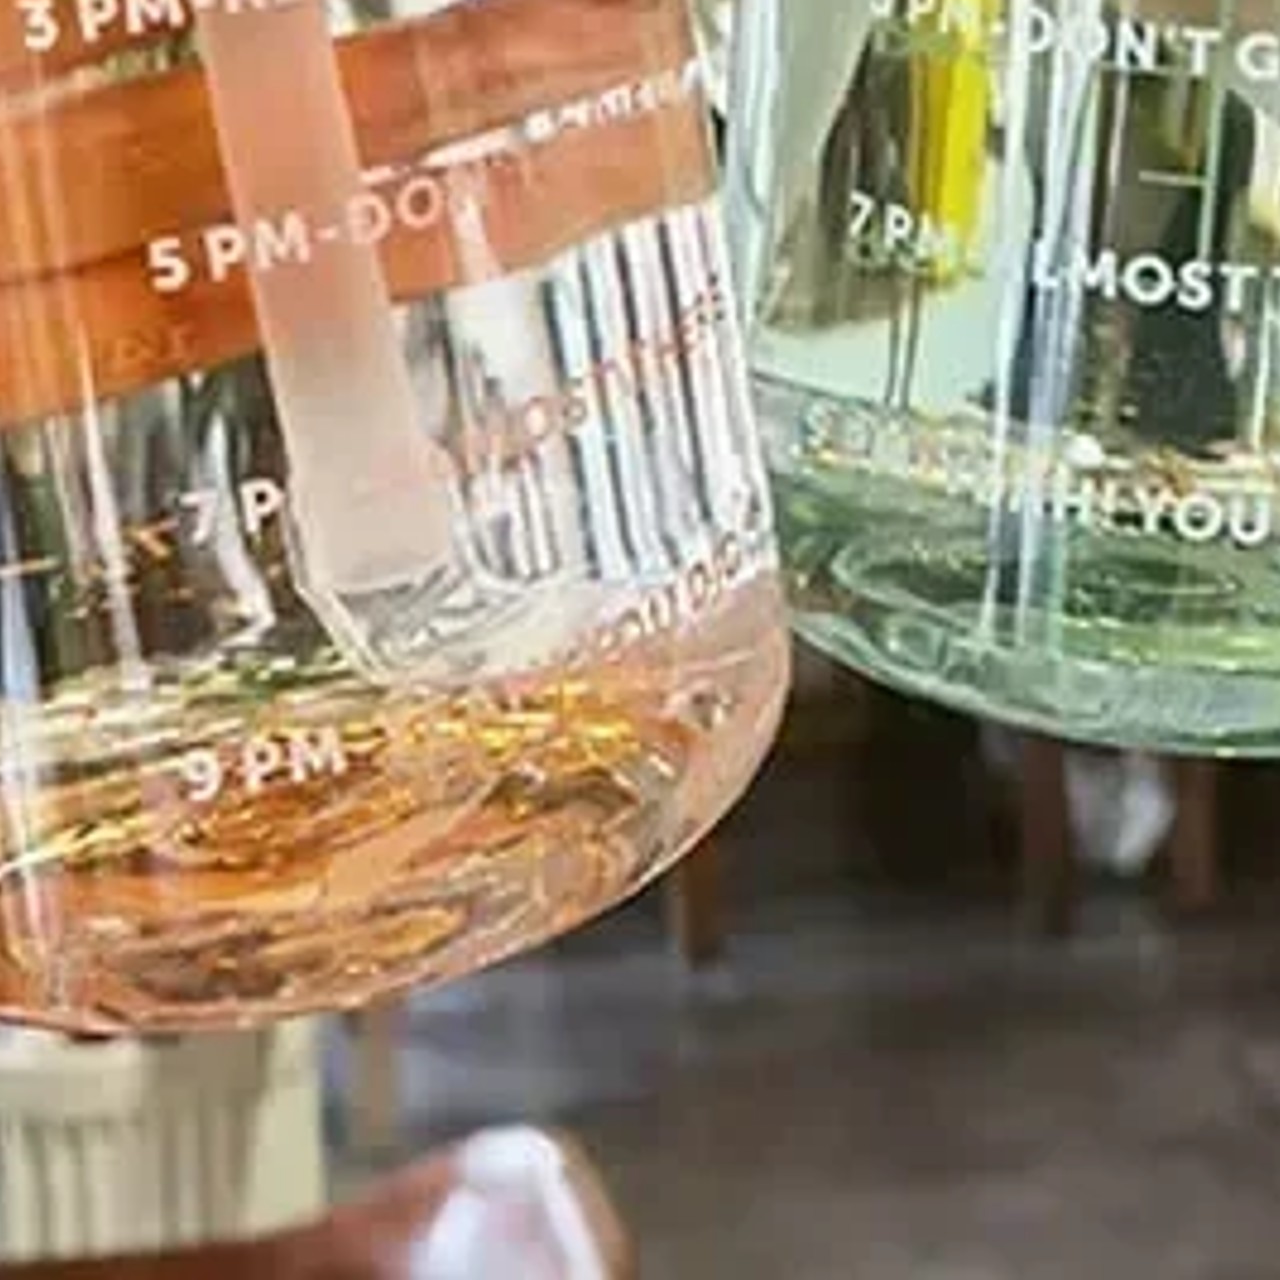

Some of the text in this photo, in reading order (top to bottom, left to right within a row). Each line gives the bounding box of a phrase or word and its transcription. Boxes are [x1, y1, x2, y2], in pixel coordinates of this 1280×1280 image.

[147, 236, 189, 291] 5
[1131, 482, 1272, 545] YOU
[181, 747, 223, 802] 9
